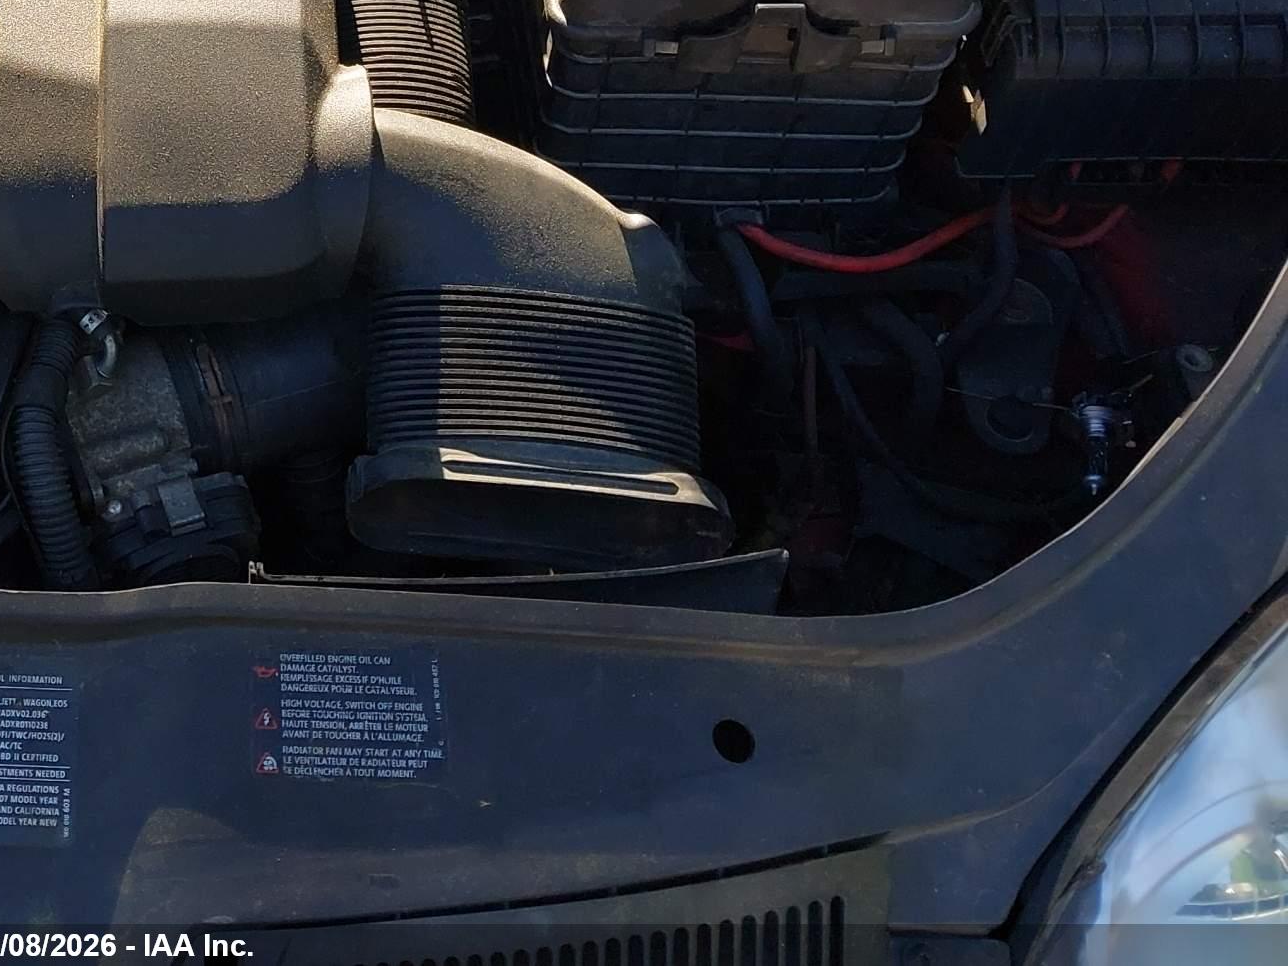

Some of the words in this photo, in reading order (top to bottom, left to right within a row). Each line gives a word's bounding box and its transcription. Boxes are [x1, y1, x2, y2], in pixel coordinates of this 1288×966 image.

[279, 653, 326, 663] OVERFILLED
[328, 655, 357, 664] ENGINE
[358, 656, 372, 664] OIL
[373, 656, 391, 665] CAN
[280, 663, 316, 672] DAMAGE
[9, 675, 63, 684] INFORMATION
[280, 673, 333, 683] REMPLISSAGE
[335, 674, 369, 684] EXCESSIF
[370, 676, 402, 685] D'HUILE
[280, 683, 329, 692] DANGEREUX
[331, 684, 353, 694] POUR
[354, 685, 364, 694] LE
[280, 699, 302, 707] HIGH
[344, 701, 376, 710] SWITCH
[377, 702, 392, 710] OFF
[394, 702, 423, 711] ENGINE
[281, 709, 311, 718] BEFORE
[311, 710, 355, 720] TOUCHING
[356, 711, 393, 721] IGNITION
[281, 719, 309, 729] HAUTE
[349, 720, 382, 731] ARRÊTER
[383, 722, 394, 731] LE
[395, 723, 429, 732] MOTEUR
[282, 730, 310, 738] AVANT
[312, 730, 322, 739] DE
[324, 731, 361, 740] TOUCHER
[282, 745, 324, 755] RADIATOR
[325, 747, 342, 755] FAN
[343, 748, 363, 756] MAY
[365, 748, 389, 757] START
[392, 749, 402, 757] AT
[404, 749, 421, 758] ANY
[21, 753, 59, 762] CERTIFIED
[283, 756, 292, 764] LE
[294, 756, 346, 766] VENTILATEUR
[349, 757, 360, 766] DE
[361, 758, 406, 768] RADIATEUR
[407, 759, 428, 768] PEUT
[35, 770, 65, 778] NEEDED
[294, 765, 344, 776] DÉCLENCHER
[353, 768, 375, 777] TOUT
[7, 784, 59, 793] REGULATIONS
[10, 795, 37, 804] MODEL
[39, 796, 58, 804] YEAR
[14, 806, 60, 816] CALIFORNIA
[18, 818, 37, 826] YEAR
[39, 818, 58, 827] NEW
